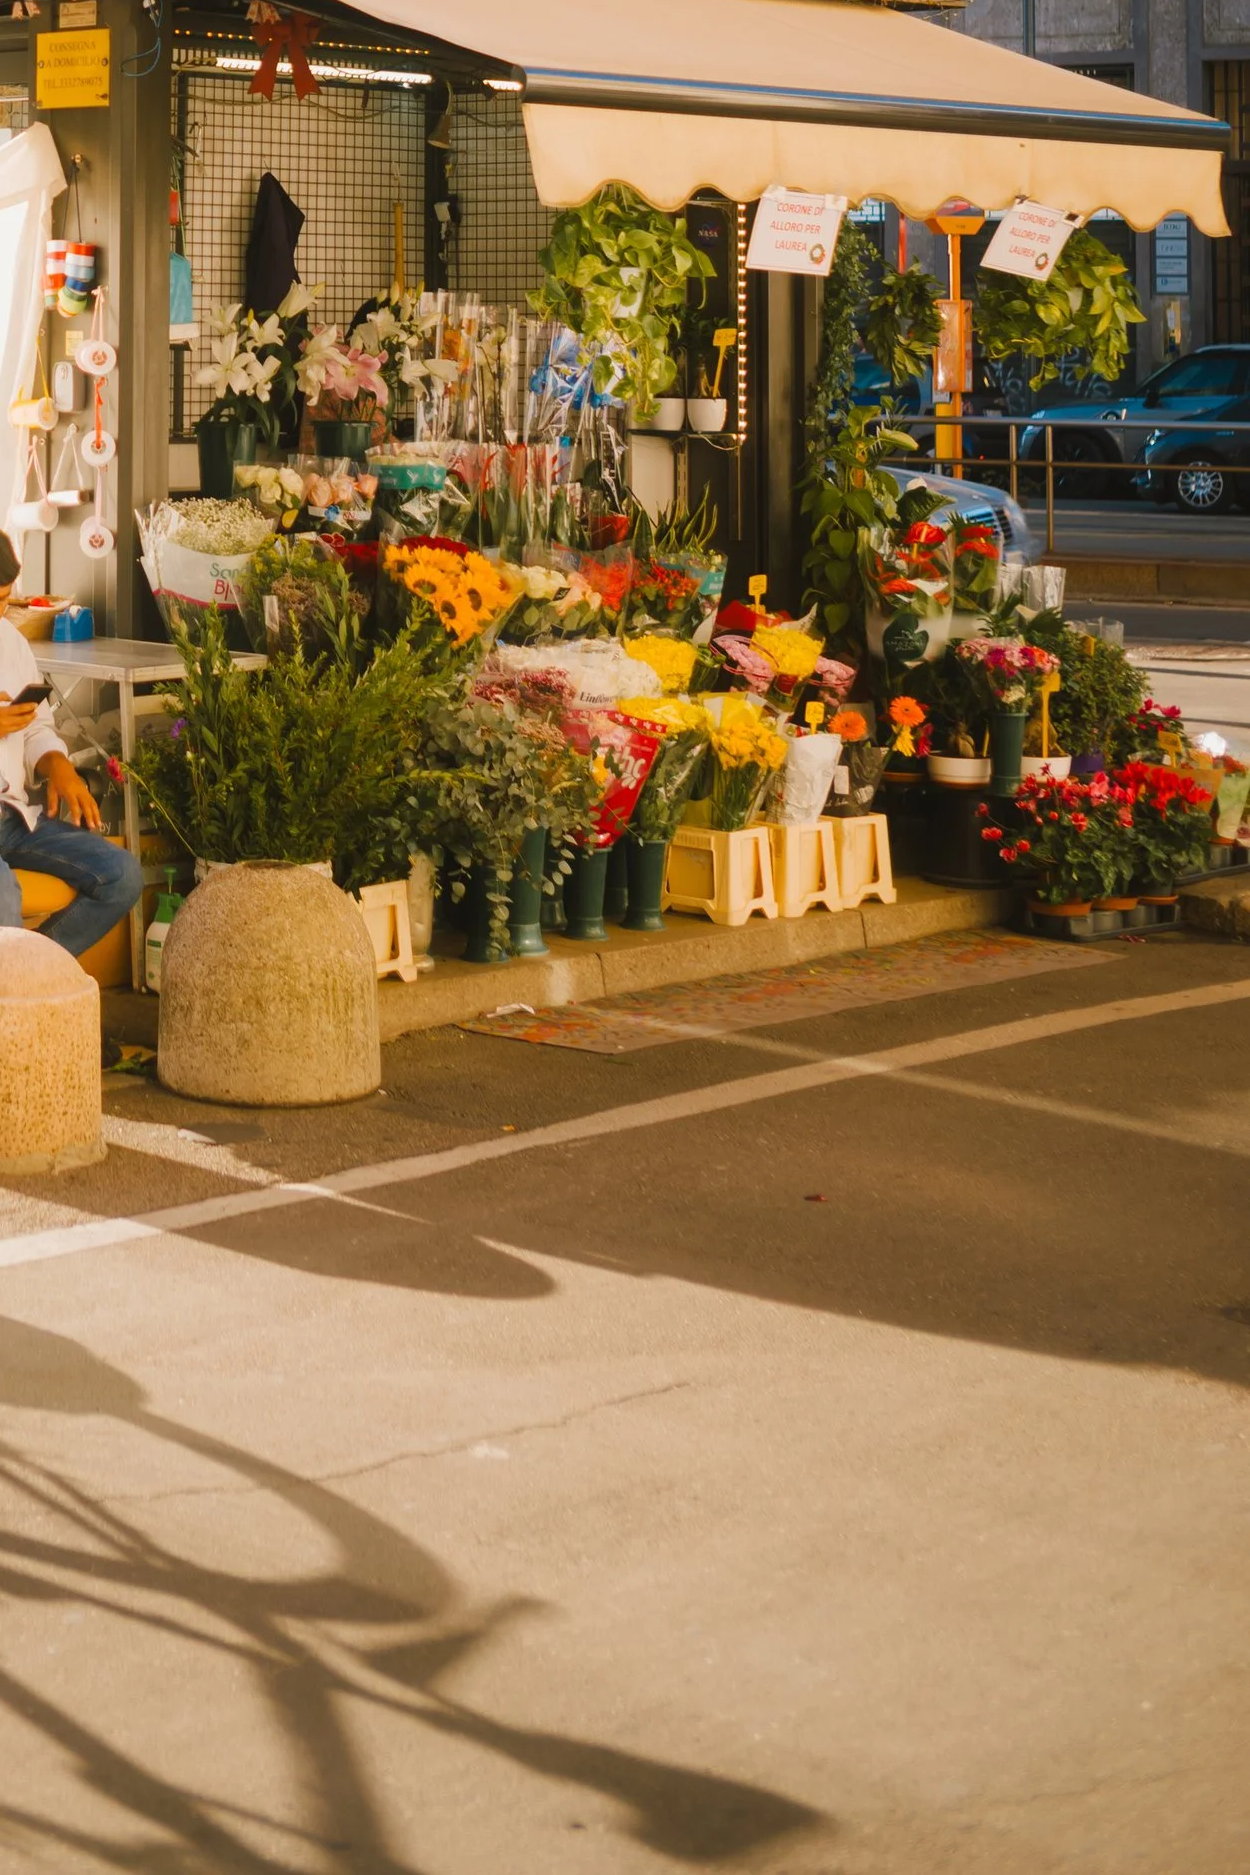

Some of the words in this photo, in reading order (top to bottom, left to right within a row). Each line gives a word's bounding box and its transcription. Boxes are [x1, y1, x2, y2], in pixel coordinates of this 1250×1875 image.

[49, 41, 96, 53] CONSEGNA
[777, 203, 812, 215] CORONE
[1019, 212, 1047, 226] CORONE
[770, 220, 803, 233] ALLORO
[805, 224, 821, 234] PER
[698, 229, 718, 238] NASA
[1009, 227, 1035, 241] ALLORO
[1036, 234, 1051, 244] PER
[775, 240, 807, 252] LAUREA
[1009, 245, 1035, 258] LAUREA
